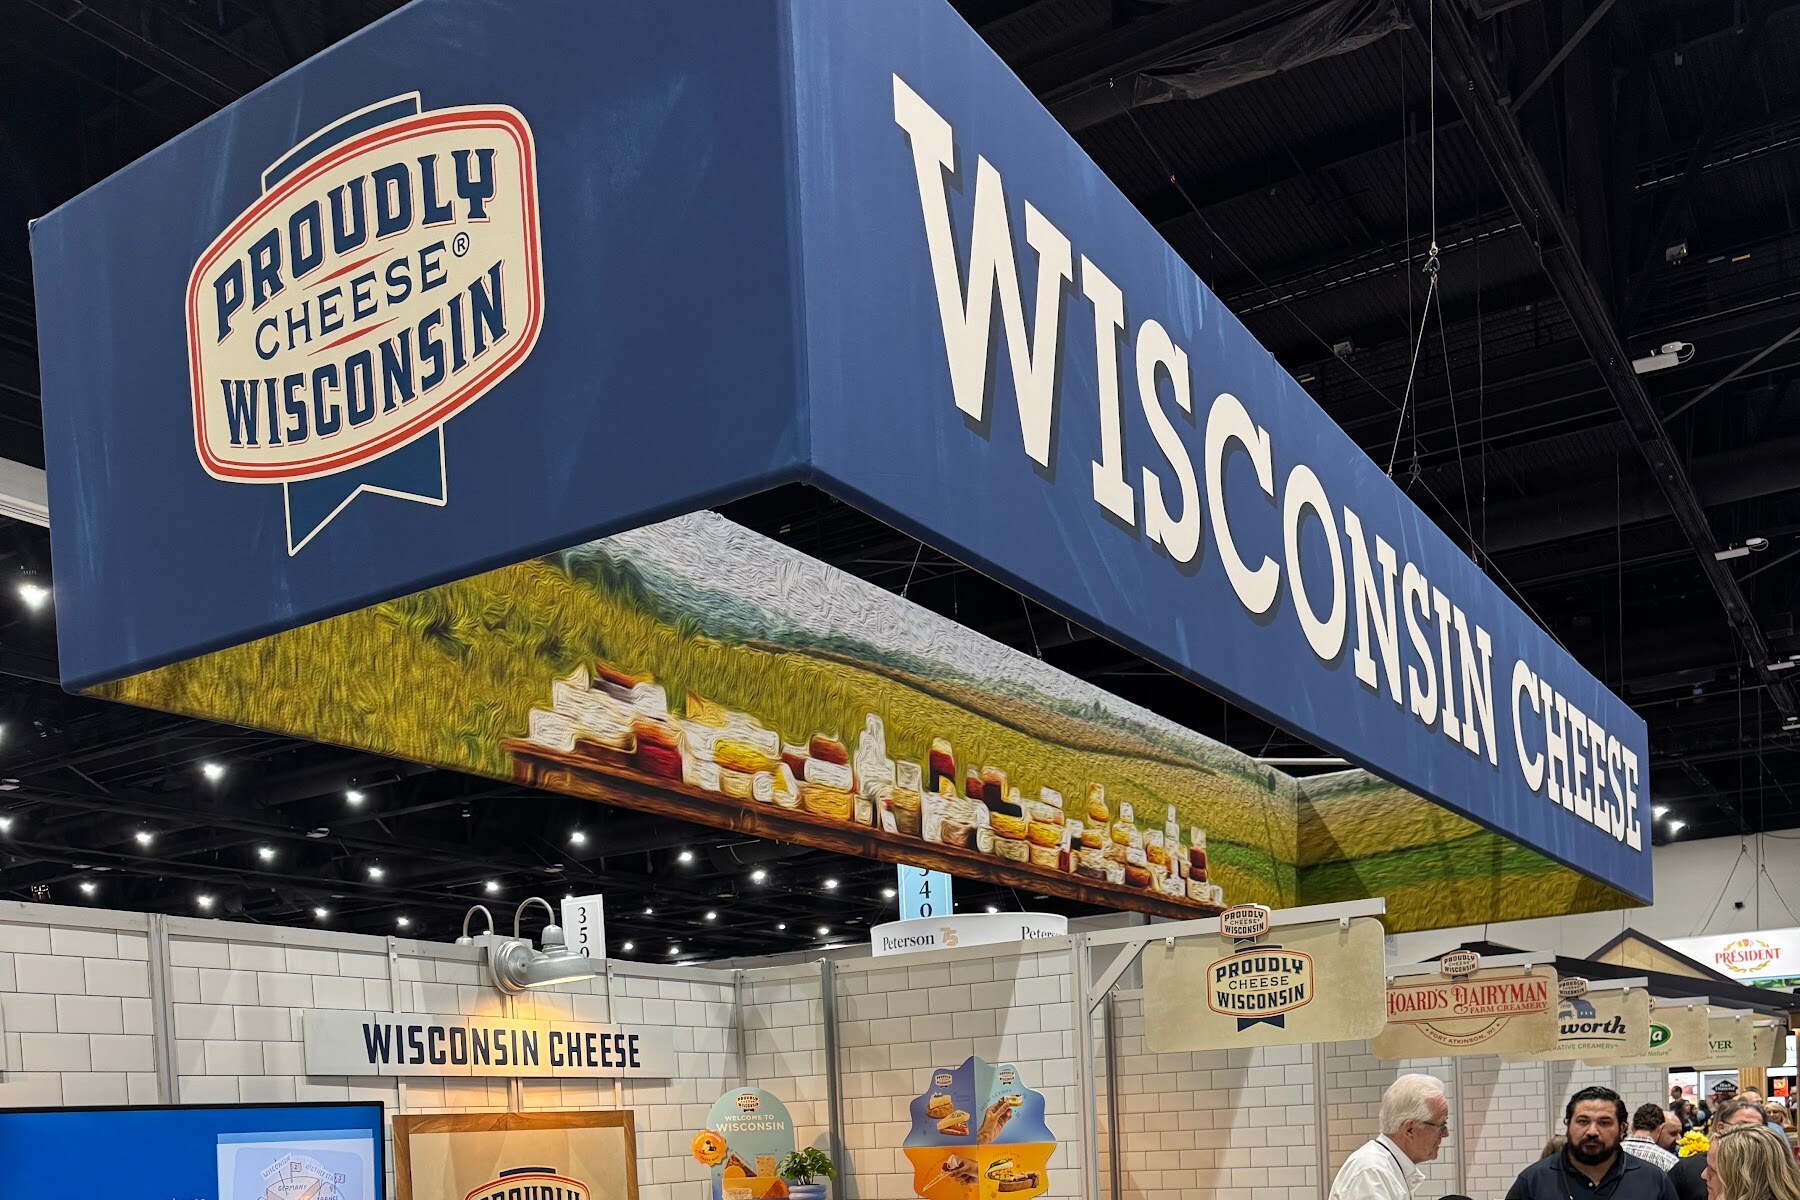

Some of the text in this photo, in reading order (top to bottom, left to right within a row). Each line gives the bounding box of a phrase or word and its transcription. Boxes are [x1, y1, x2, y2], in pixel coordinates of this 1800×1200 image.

[213, 148, 497, 344] PROUDLY
[220, 260, 507, 449] WISCONSIN
[892, 73, 1643, 853] WISCONSIN CHEESE
[919, 868, 933, 918] 40
[1224, 910, 1264, 921] PROUDLY
[1021, 926, 1059, 940] Peter
[1224, 922, 1264, 935] WISCONSIN
[883, 934, 935, 951] Peterson
[1443, 954, 1475, 965] PROUDLY
[1715, 948, 1781, 965] PRÉSIDENT
[1216, 957, 1304, 983] PROUDLY
[1444, 964, 1476, 973] WISCONSIN
[1228, 975, 1290, 990] CHEESE
[1217, 983, 1305, 1010] WISCONSIN
[1451, 981, 1548, 1015] DAIRYMAN
[1469, 1004, 1495, 1014] FARM
[1496, 1001, 1548, 1012] CREAMERY
[1560, 1016, 1626, 1035] worth
[1429, 1027, 1496, 1045] FORT ATKINSON, WI
[362, 1023, 641, 1068] WISCONSIN CHEESE
[715, 1121, 785, 1133] WISCONSIN
